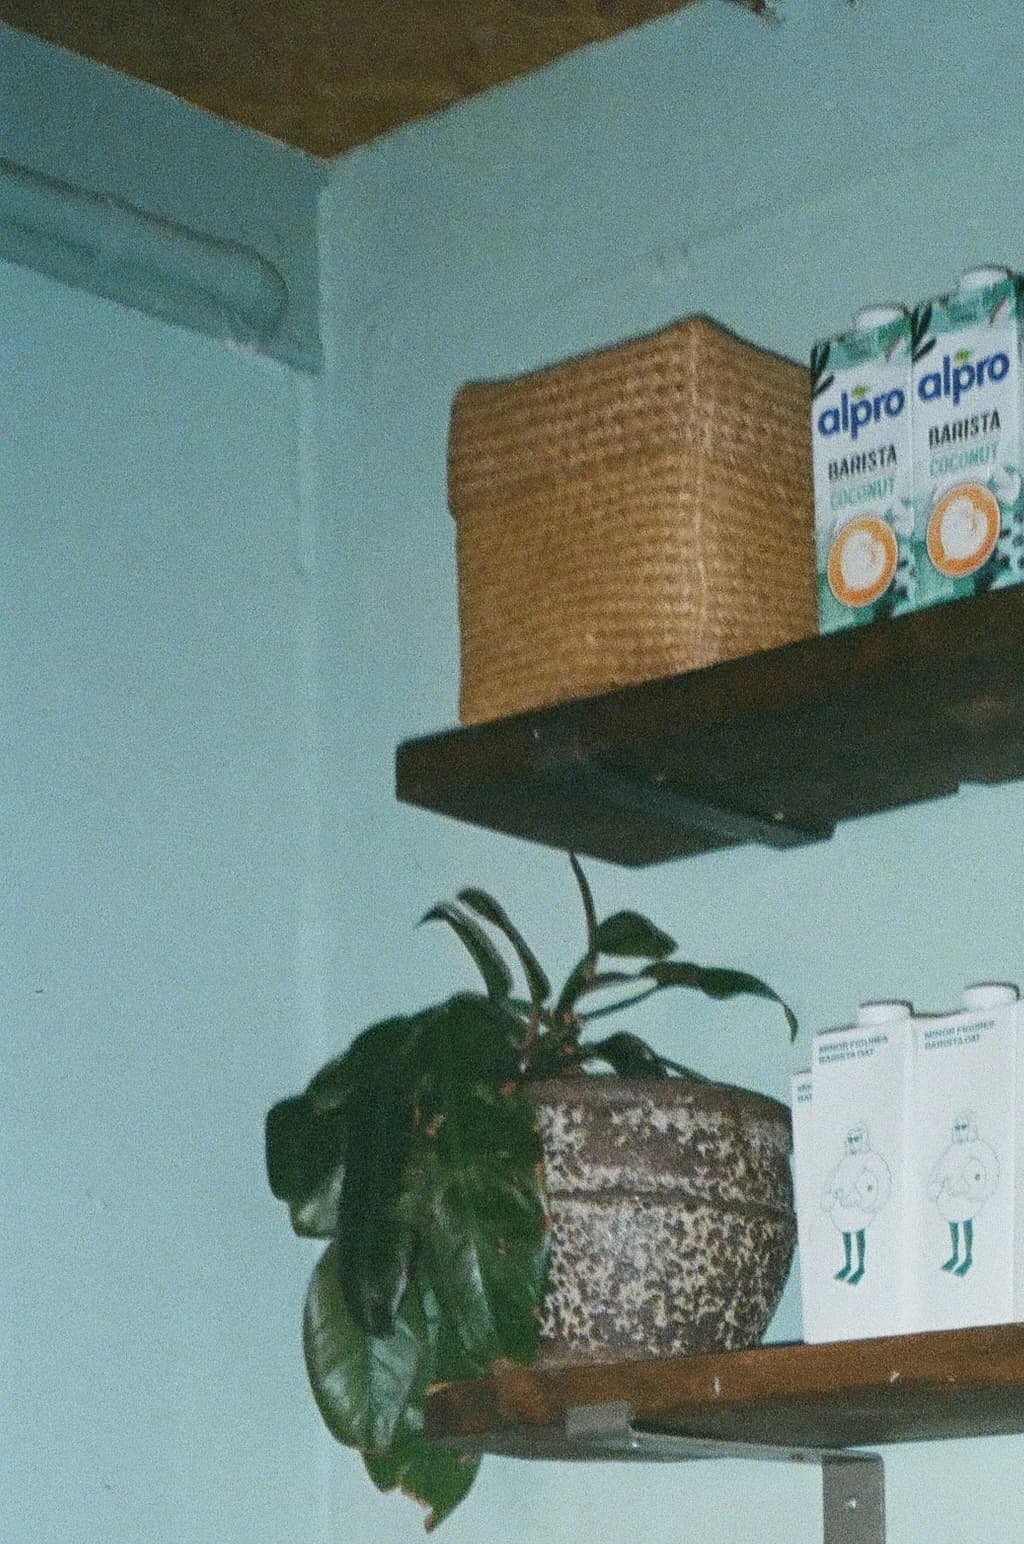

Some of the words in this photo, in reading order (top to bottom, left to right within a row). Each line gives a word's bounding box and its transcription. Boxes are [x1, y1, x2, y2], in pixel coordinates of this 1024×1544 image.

[917, 351, 1010, 406] alpro
[817, 387, 906, 441] alpro
[928, 409, 1001, 449] BARISTA
[828, 443, 898, 482] BARISTA
[929, 443, 998, 477] COCONUT
[830, 477, 896, 511] COCONUT
[819, 1050, 856, 1065] BARISTA
[924, 1036, 963, 1050] BARISTA
